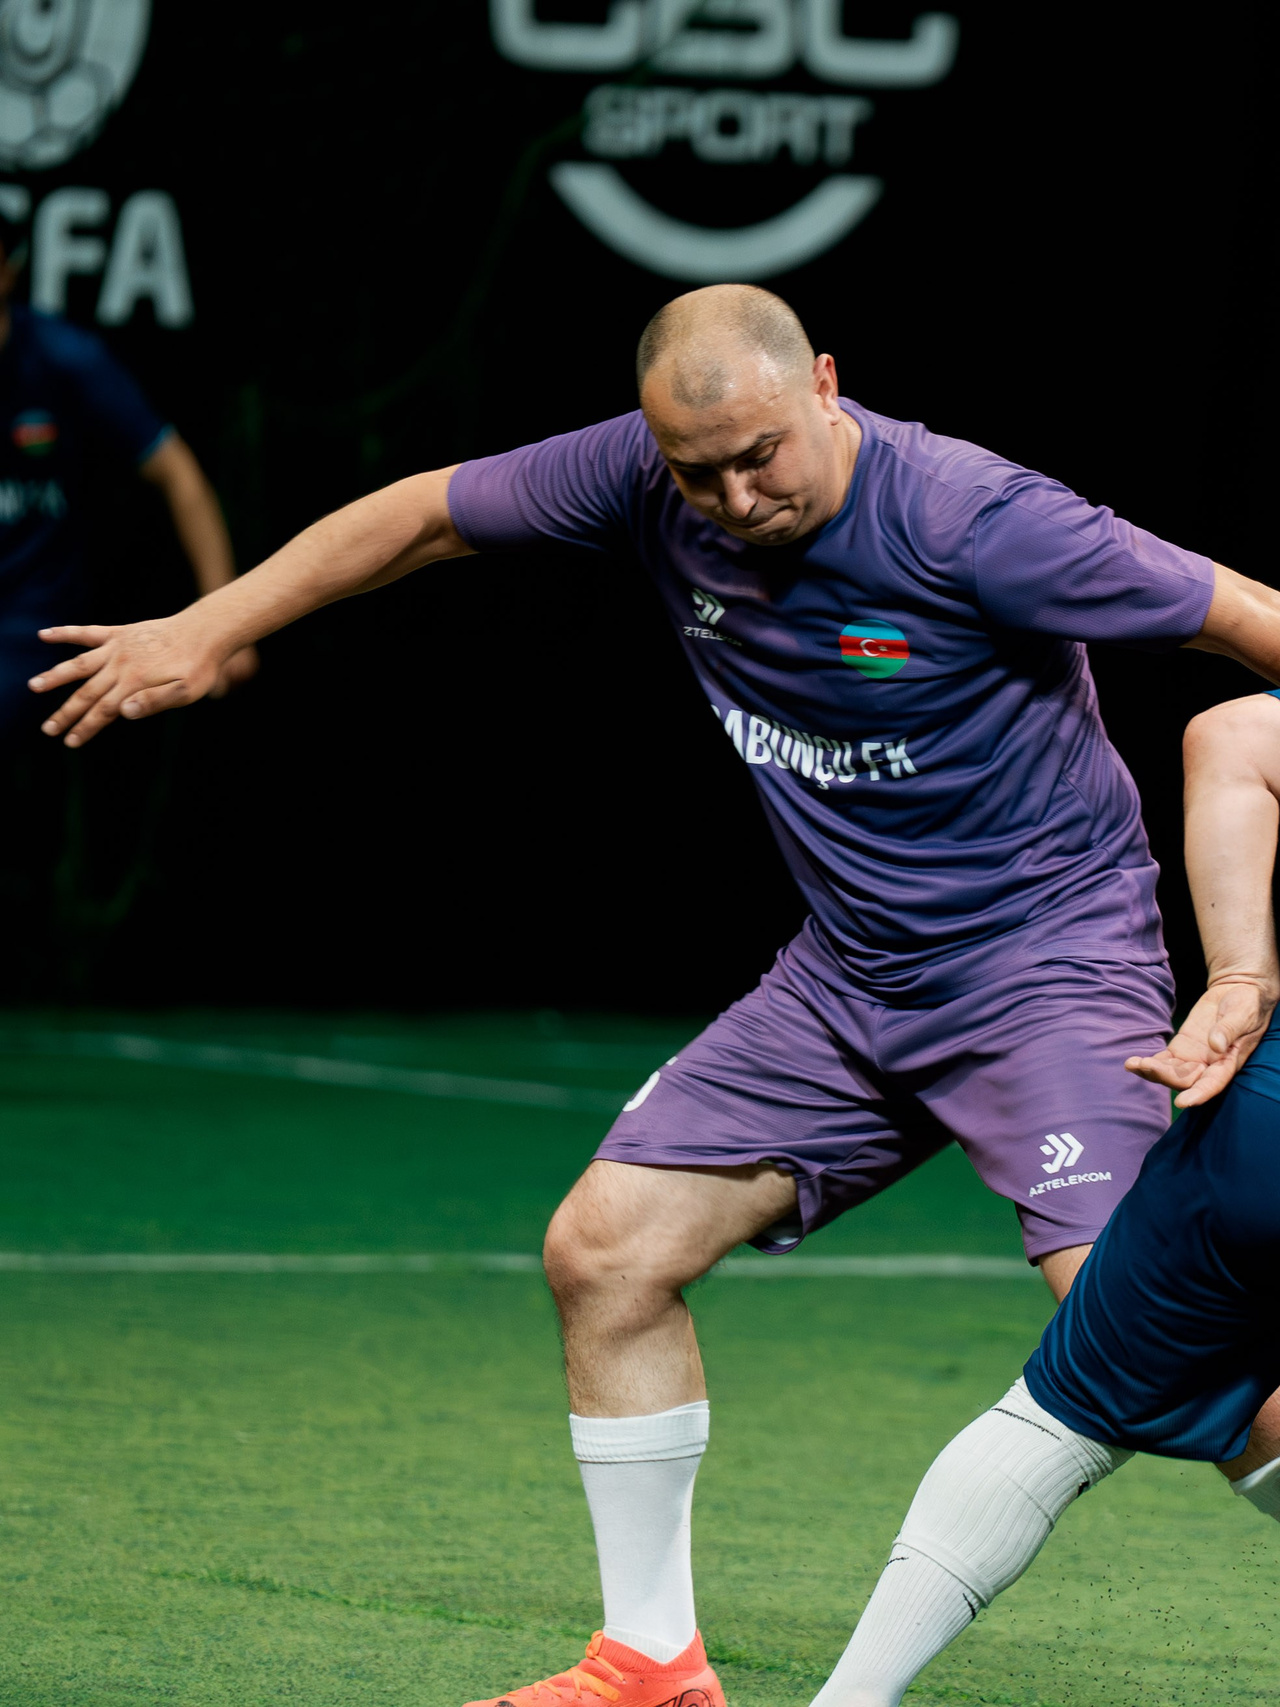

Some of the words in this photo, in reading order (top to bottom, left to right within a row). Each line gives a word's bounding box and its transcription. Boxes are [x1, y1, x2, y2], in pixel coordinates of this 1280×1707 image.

[583, 84, 872, 166] SPORT
[0, 182, 195, 328] FA
[861, 737, 918, 781] FK
[1029, 1171, 1112, 1198] AZTELEKOM
